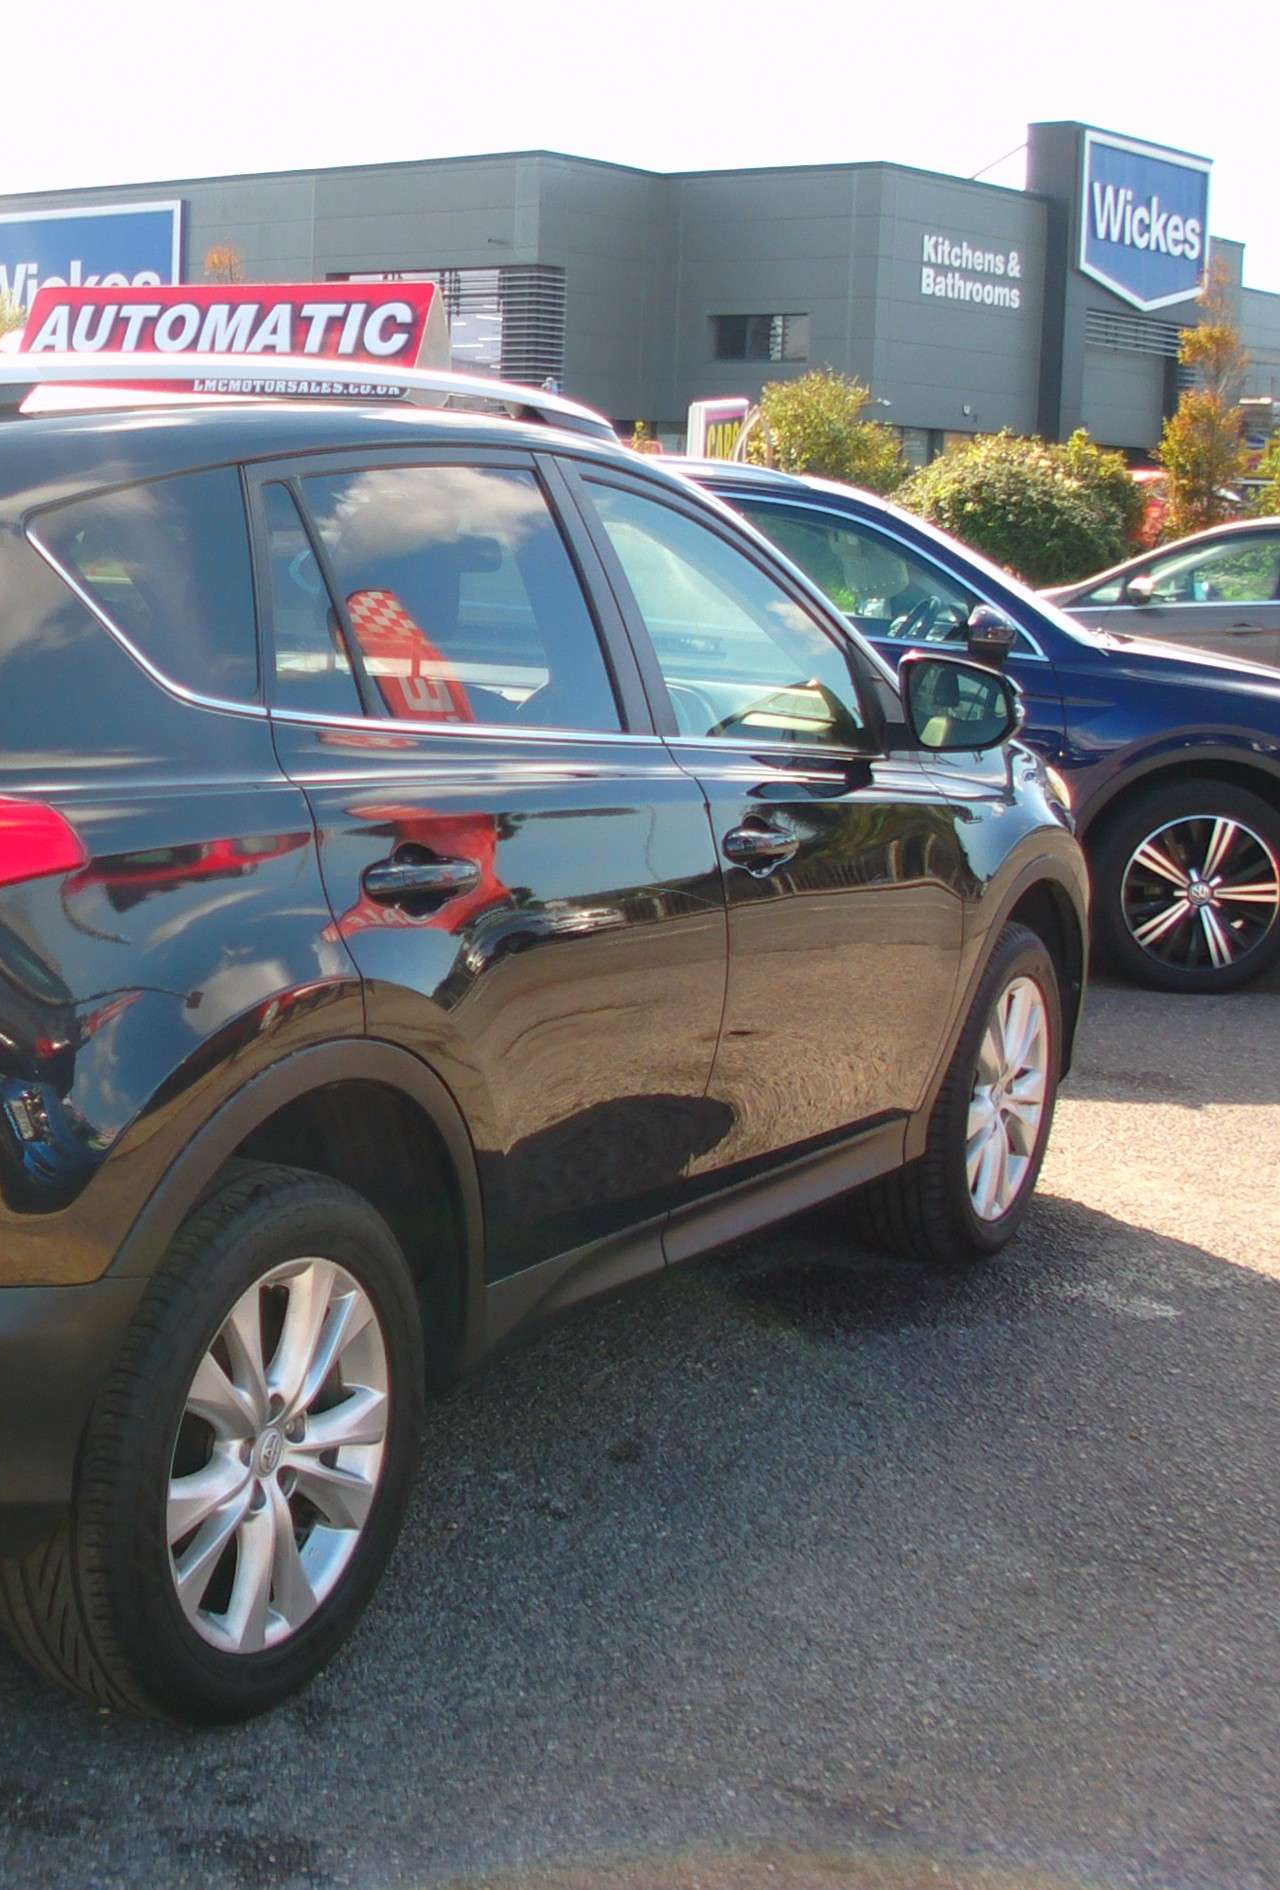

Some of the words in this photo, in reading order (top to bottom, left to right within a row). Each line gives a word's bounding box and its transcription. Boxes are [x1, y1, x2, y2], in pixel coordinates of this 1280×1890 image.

[1092, 181, 1201, 260] Wickes
[922, 235, 1005, 275] Kitchens
[1007, 251, 1021, 278] &
[920, 267, 1020, 308] Bathrooms
[29, 302, 412, 356] AUTOMATIC
